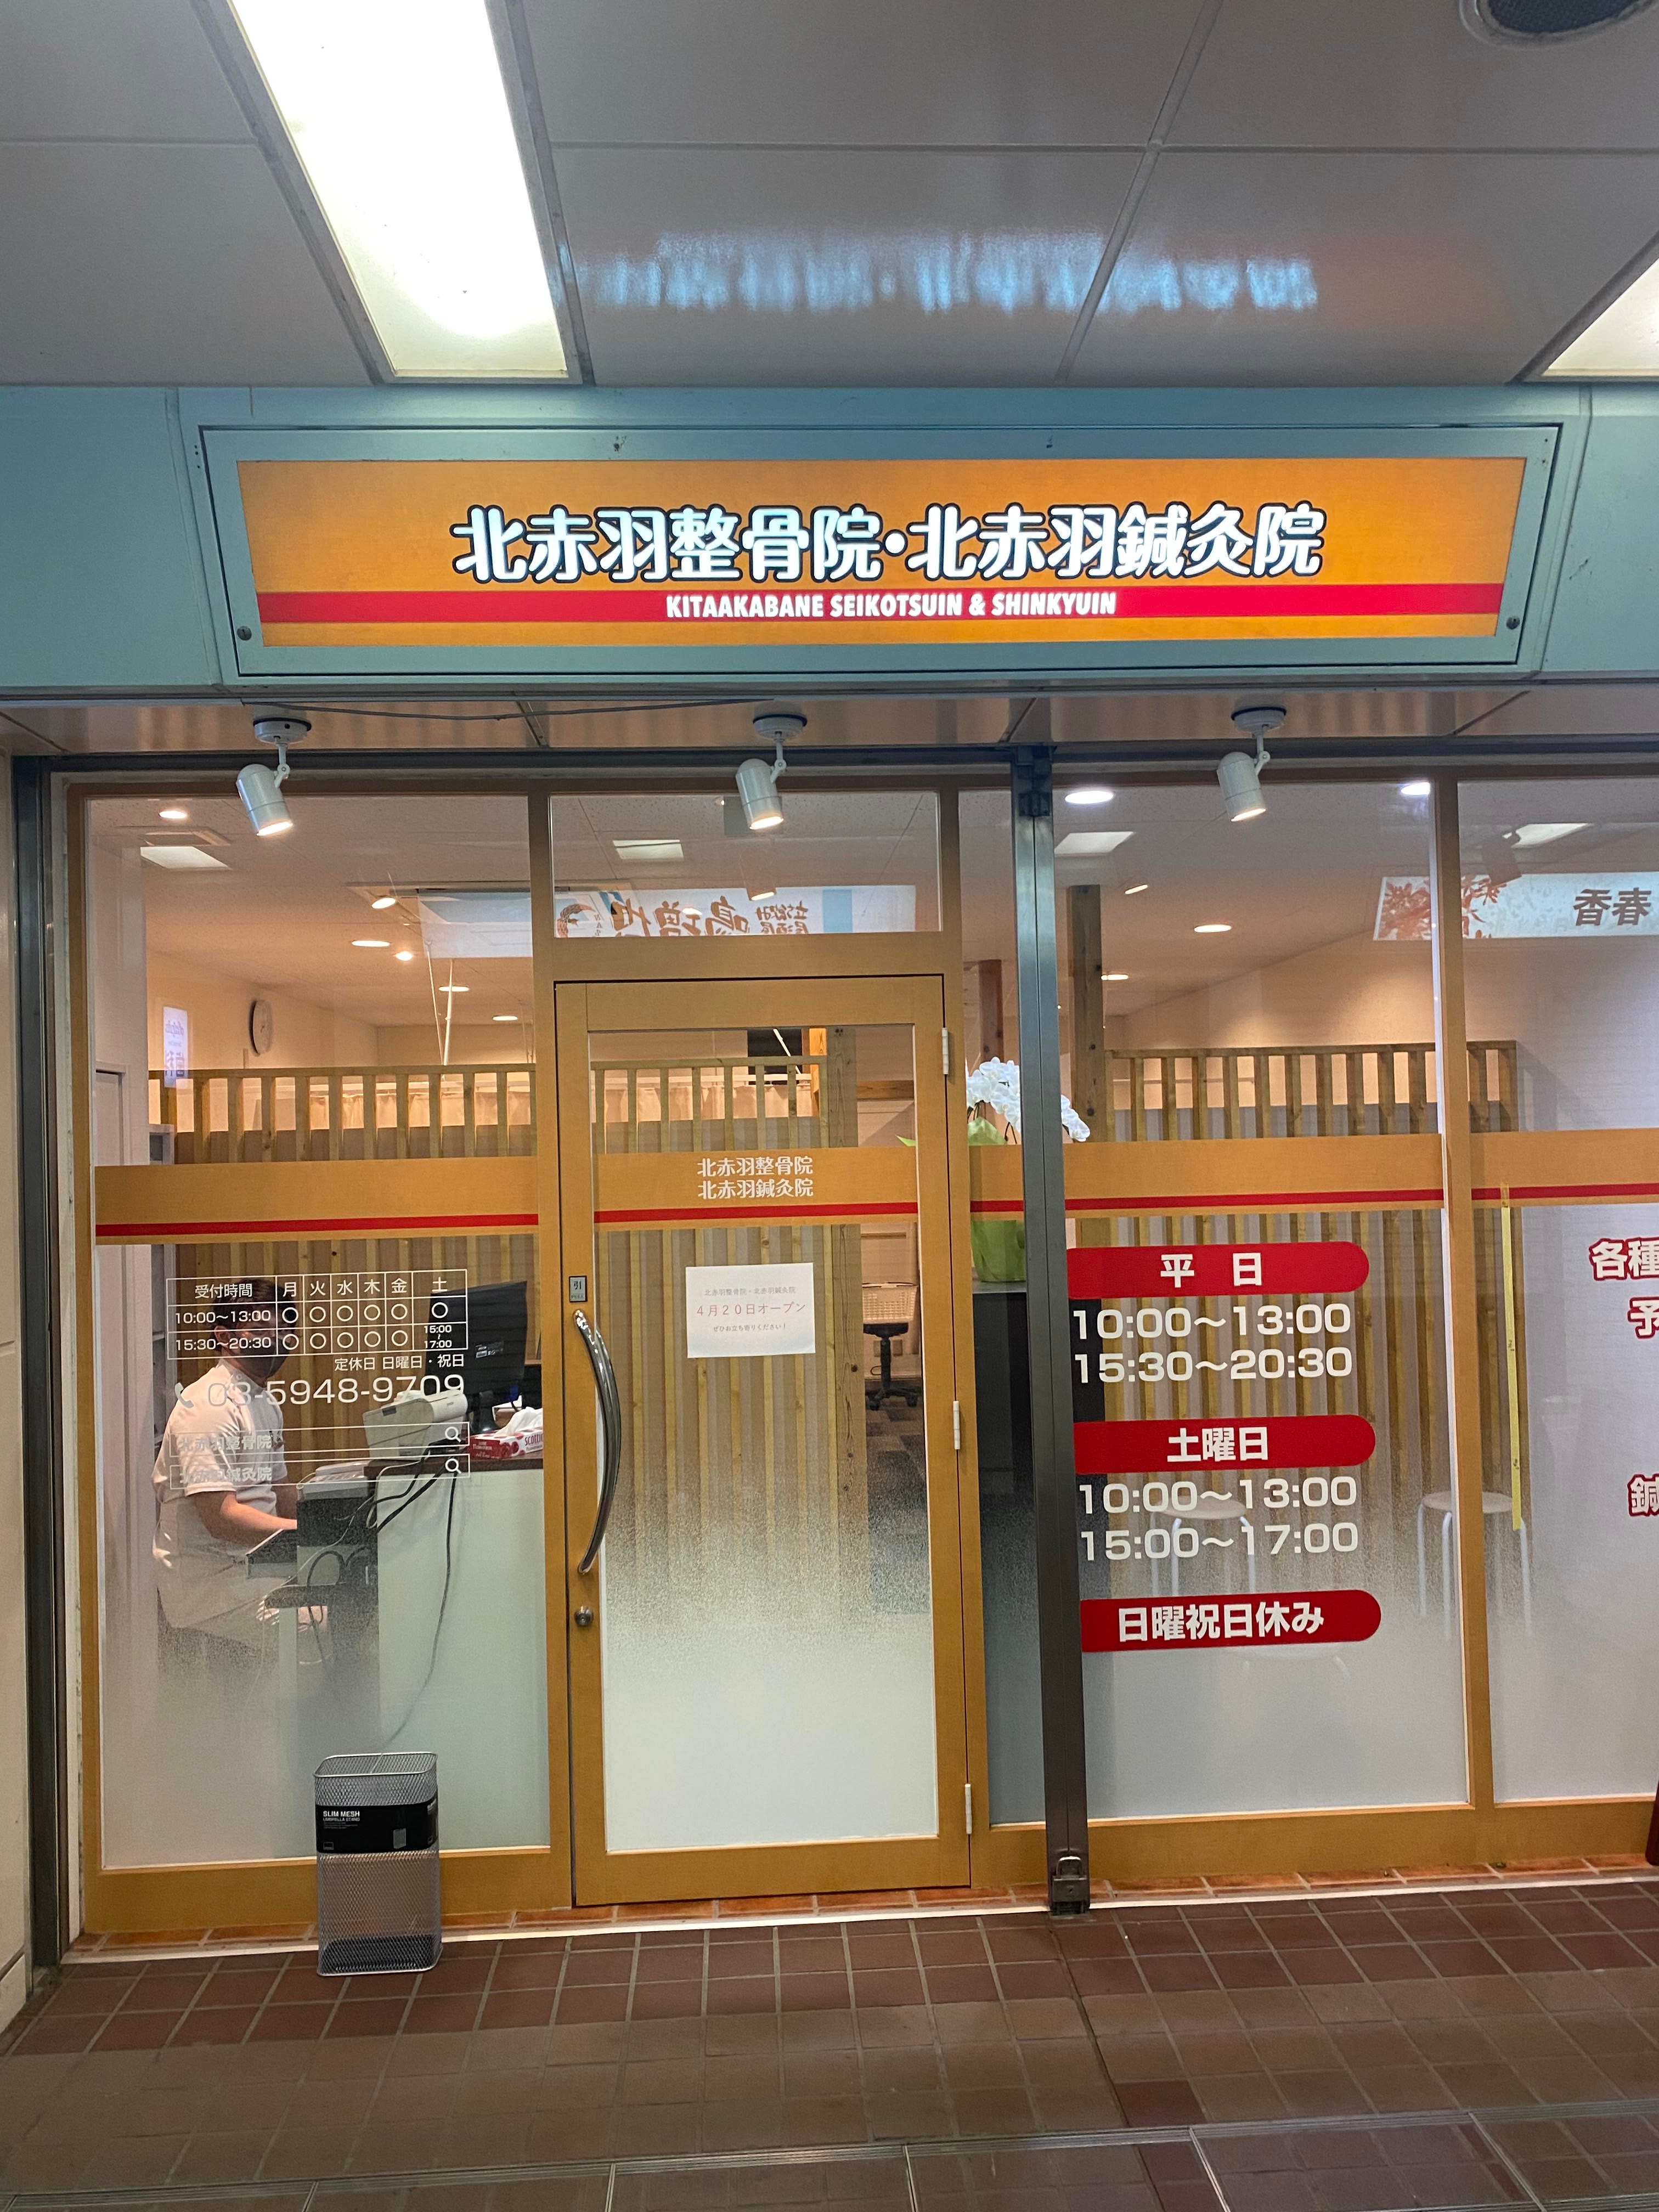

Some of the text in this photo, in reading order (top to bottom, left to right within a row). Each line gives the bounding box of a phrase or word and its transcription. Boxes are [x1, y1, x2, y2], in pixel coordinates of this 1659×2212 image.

[450, 500, 1327, 584] 北赤羽整骨院・北赤羽鍼灸院
[665, 590, 1118, 620] KITAAKABANE SEIKOTSUIN & SHINKYUIN
[697, 1155, 814, 1177] 北赤羽整骨院
[697, 1178, 814, 1200] 北赤羽鍼灸院
[1588, 1237, 1659, 1281] 各種
[195, 1277, 448, 1299] 受付時間 月 火 水 木 金 土
[424, 1325, 452, 1334] 15:00
[1627, 1296, 1659, 1339] 予
[424, 1340, 452, 1349] 17:00
[335, 1353, 465, 1373] 定休日 日曜日・祝日
[1167, 1427, 1269, 1463] 土曜日
[1118, 1602, 1324, 1642] 日曜祝日休み
